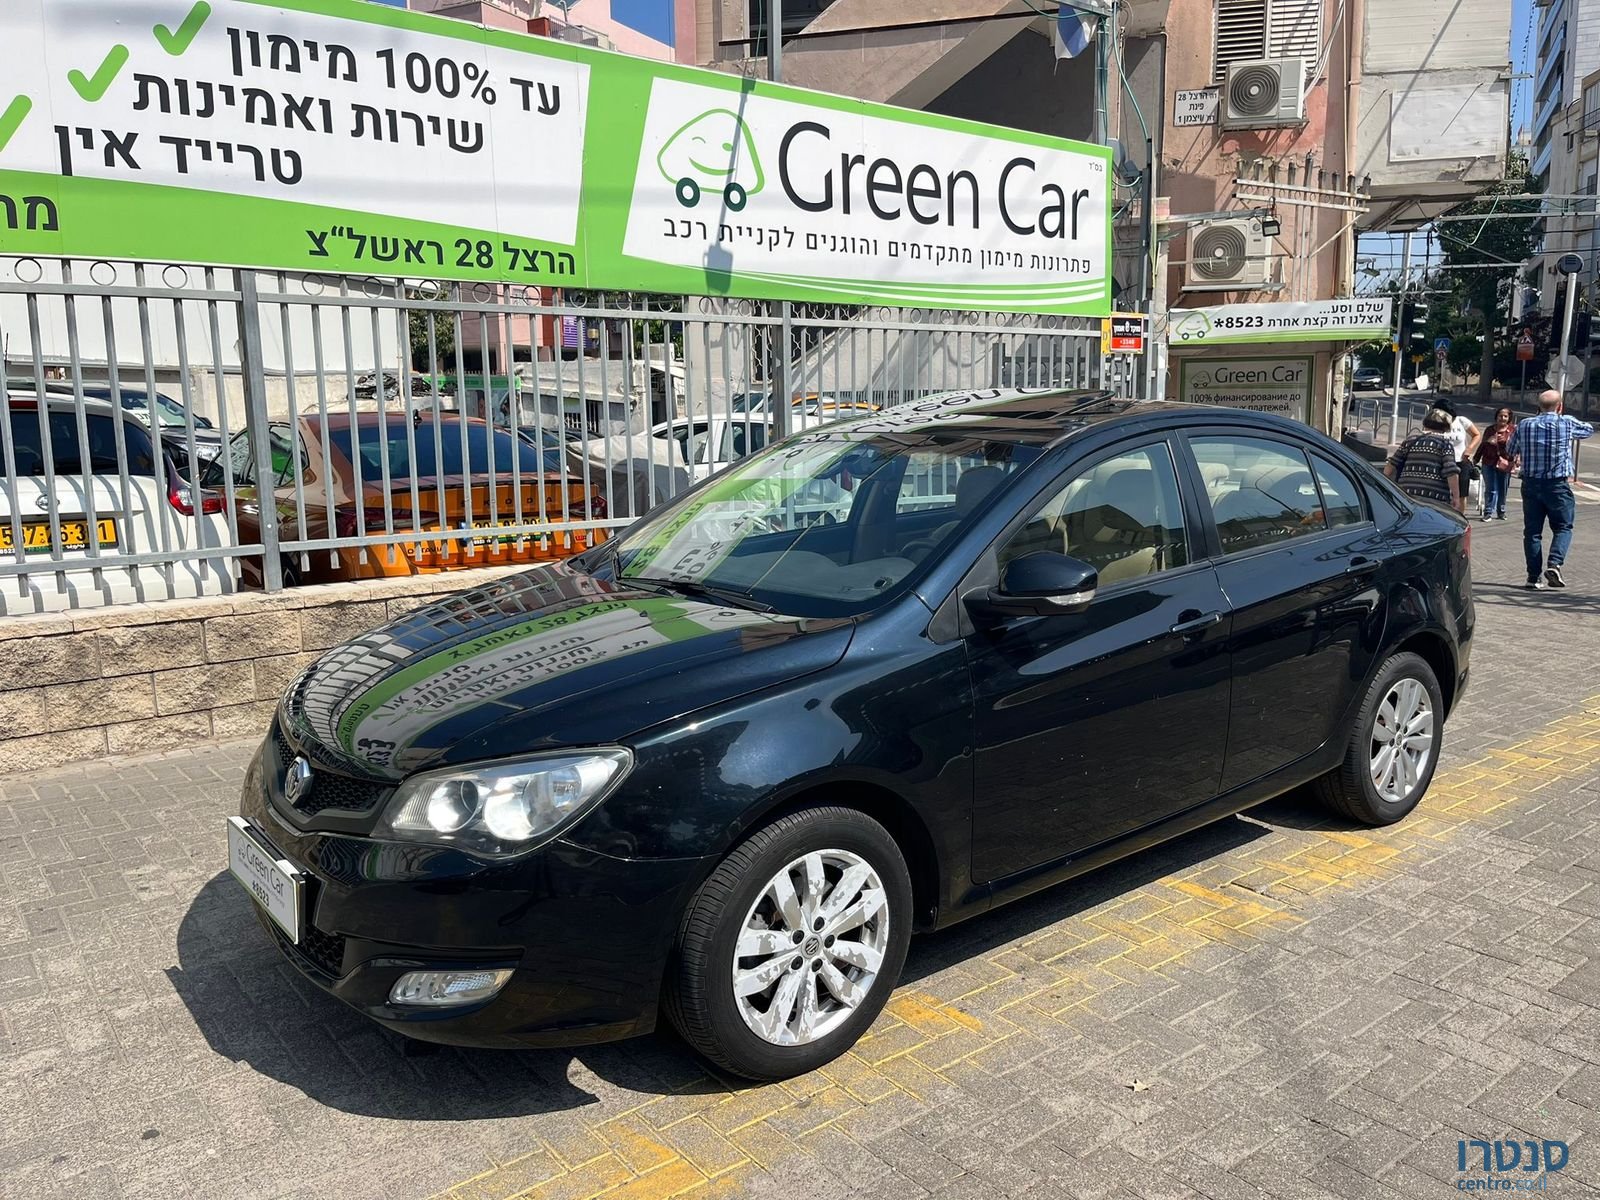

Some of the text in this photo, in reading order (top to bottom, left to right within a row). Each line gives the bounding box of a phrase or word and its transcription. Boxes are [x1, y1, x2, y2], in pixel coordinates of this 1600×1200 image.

[227, 27, 559, 116] עד 100% מימון
[1178, 93, 1187, 101] 28
[132, 73, 484, 154] שירות ואמינות
[1188, 102, 1205, 111] פינת
[1178, 115, 1183, 123] 1
[54, 125, 303, 185] טרייד אין
[778, 121, 1089, 240] Green Car
[454, 238, 494, 269] 28
[663, 218, 1091, 274] פתרונות מימון מתקדמים והוגנים לקניית רכב
[502, 241, 575, 276] הרצל
[1356, 302, 1384, 313] שלם
[1267, 318, 1299, 327] אחרת
[1302, 316, 1328, 328] קצת
[1331, 315, 1346, 325] זה
[1349, 313, 1383, 324] אצלנו
[1214, 365, 1303, 383] Green Car
[1213, 392, 1288, 404] финансирование
[1290, 393, 1301, 402] до
[246, 844, 284, 897] Green Car
